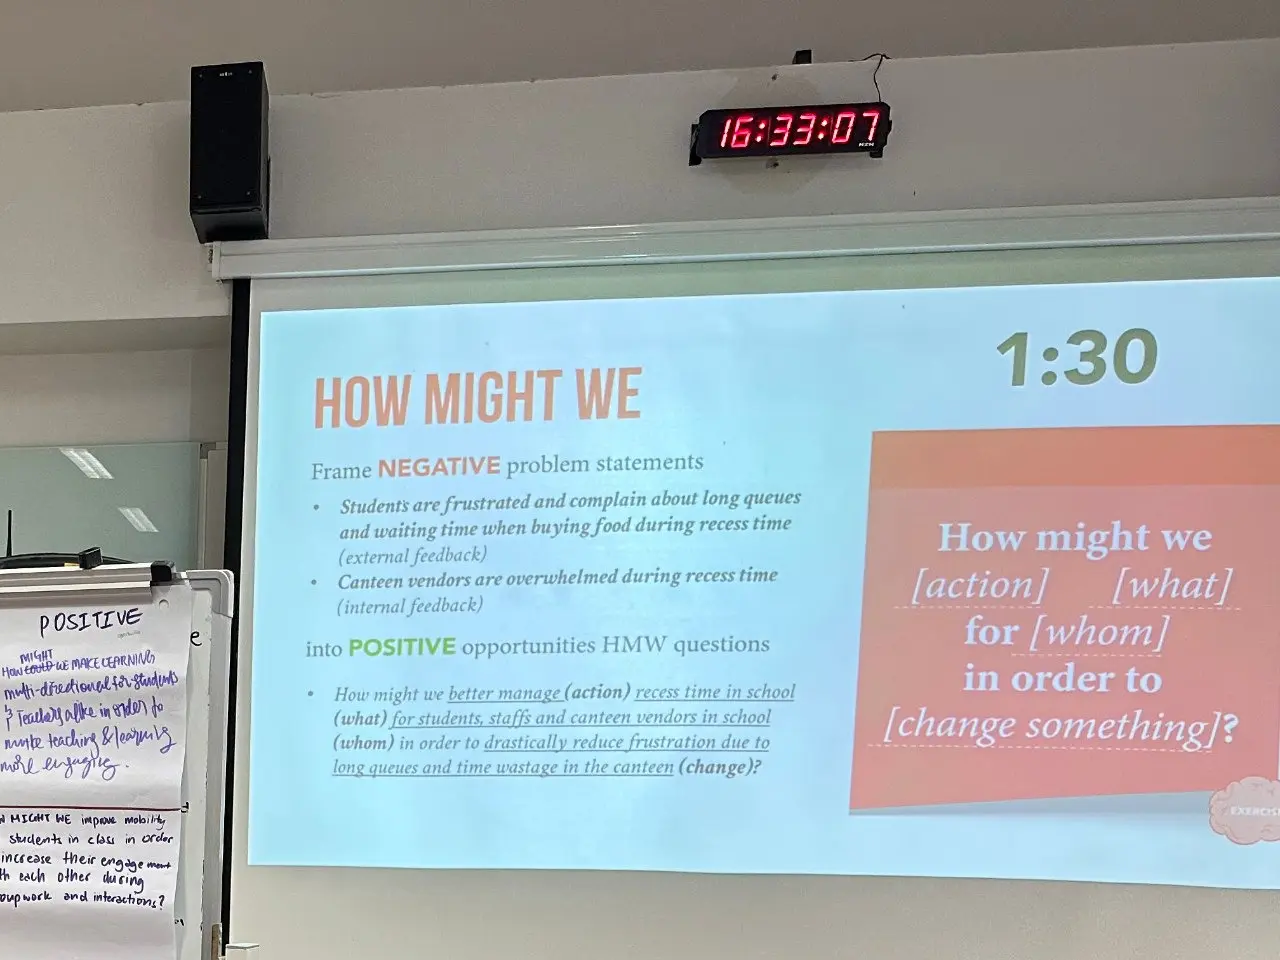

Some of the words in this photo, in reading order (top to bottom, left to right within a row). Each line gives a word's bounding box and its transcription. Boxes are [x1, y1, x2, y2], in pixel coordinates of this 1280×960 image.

[720, 112, 880, 148] 16:33:07
[997, 328, 1158, 386] 1:30
[314, 375, 412, 429] HOW
[424, 369, 563, 425] MIGHT
[576, 366, 642, 420] WE
[311, 462, 372, 481] Frame
[378, 456, 500, 478] NEGATIVE
[506, 453, 589, 481] problem
[596, 454, 704, 473] statements
[340, 498, 410, 515] Students
[413, 501, 440, 513] are
[440, 495, 531, 516] frustrated
[534, 493, 566, 509] and
[570, 491, 643, 512] complain
[651, 490, 697, 506] about
[703, 490, 739, 509] long
[744, 491, 802, 509] queues
[340, 524, 370, 540] and
[375, 521, 436, 541] waiting
[441, 520, 478, 537] time
[482, 520, 532, 535] when
[531, 518, 590, 538] buying
[590, 516, 632, 538] food
[635, 516, 699, 536] during
[700, 518, 749, 531] recess
[753, 515, 792, 530] time
[938, 522, 1025, 552] How
[1035, 521, 1149, 561] might
[1161, 528, 1211, 552] we
[338, 548, 409, 567] (external
[410, 545, 487, 567] feedback)
[338, 574, 403, 590] Canteen
[408, 572, 470, 588] vendors
[475, 575, 502, 587] are
[506, 568, 618, 586] overwhelmed
[622, 567, 681, 588] during
[686, 571, 735, 583] recess
[739, 567, 778, 582] time
[911, 567, 1049, 605] [action]
[1111, 567, 1233, 605] [what]
[337, 598, 405, 617] (internal
[407, 595, 484, 617] feedback)
[40, 607, 143, 639] POSITIVE
[964, 615, 1020, 647] for
[1030, 614, 1169, 652] [whom]
[20, 649, 53, 664] MIGHT
[306, 641, 342, 657] into
[349, 638, 456, 656] POSITIVE
[463, 636, 595, 659] opportunities
[602, 636, 667, 653] HMW
[674, 636, 770, 656] questions
[71, 657, 101, 670] MAKE
[963, 663, 999, 692] in
[1011, 663, 1114, 693] order
[1125, 666, 1161, 693] to
[335, 687, 370, 702] How
[373, 686, 419, 705] might
[424, 690, 444, 701] we
[448, 685, 493, 700] better
[498, 688, 561, 704] manage
[565, 682, 631, 701] (action)
[636, 686, 679, 699] recess
[684, 685, 720, 699] time
[726, 684, 742, 699] in
[746, 684, 796, 699] school
[334, 710, 387, 727] (what)
[391, 710, 415, 729] for
[418, 710, 483, 726] students,
[489, 709, 531, 728] staffs
[535, 709, 566, 724] and
[570, 711, 630, 724] canteen
[637, 709, 697, 724] vendors
[702, 709, 718, 724] in
[723, 709, 771, 724] school
[884, 706, 1016, 747] [change
[1025, 710, 1239, 752] something]?
[333, 734, 394, 751] (whom)
[399, 735, 413, 750] in
[420, 735, 461, 750] order
[465, 736, 479, 749] to
[484, 734, 567, 752] drastically
[573, 735, 624, 749] reduce
[626, 733, 716, 752] frustration
[721, 734, 749, 749] due
[755, 736, 770, 749] to
[333, 760, 365, 777] long
[369, 762, 418, 777] queues
[423, 760, 451, 774] and
[456, 760, 491, 774] time
[496, 761, 558, 777] wastage
[563, 759, 579, 774] in
[585, 758, 602, 774] the
[614, 760, 674, 774] canteen
[679, 757, 762, 778] (change)?
[10, 813, 50, 823] MIGHT
[55, 814, 71, 824] WE
[81, 814, 117, 828] improve
[124, 814, 166, 830] mobility
[9, 833, 62, 845] students
[68, 834, 79, 844] in
[88, 833, 115, 845] class
[126, 834, 136, 844] in
[141, 832, 174, 844] order
[1, 851, 52, 864] increase
[62, 851, 96, 865] their
[19, 868, 46, 882] each
[57, 868, 90, 883] other
[103, 871, 144, 894] during
[64, 891, 88, 902] and
[93, 890, 165, 911] interactions?
